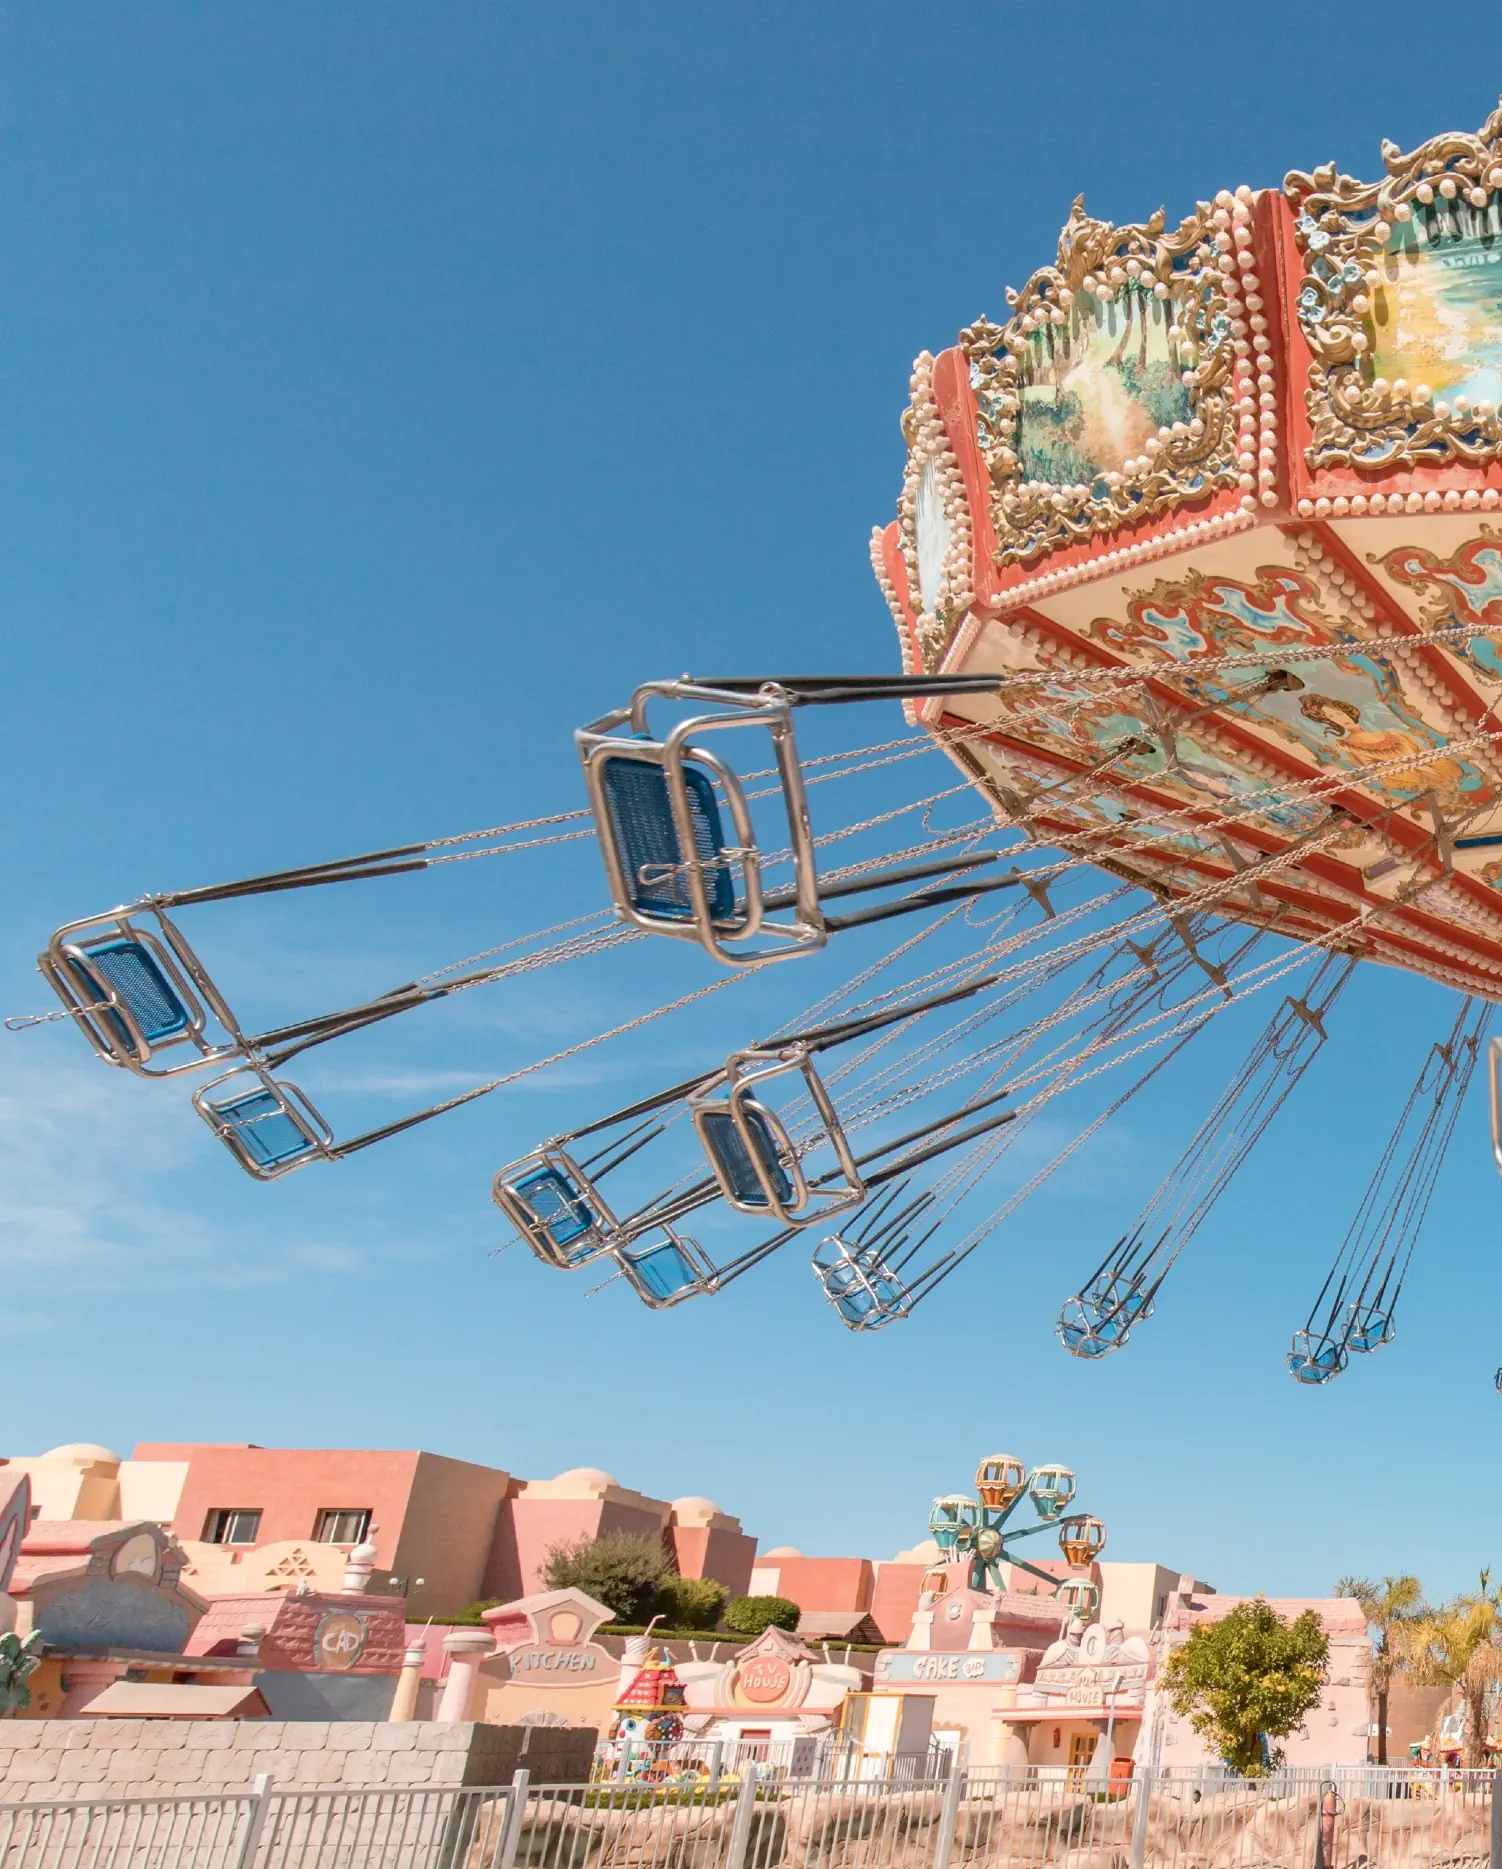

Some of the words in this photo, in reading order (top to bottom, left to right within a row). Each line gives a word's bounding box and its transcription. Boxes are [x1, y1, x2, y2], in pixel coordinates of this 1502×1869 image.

[509, 1650, 596, 1673] KITCHEN
[913, 1656, 959, 1679] CAKE
[965, 1662, 982, 1676] BAR
